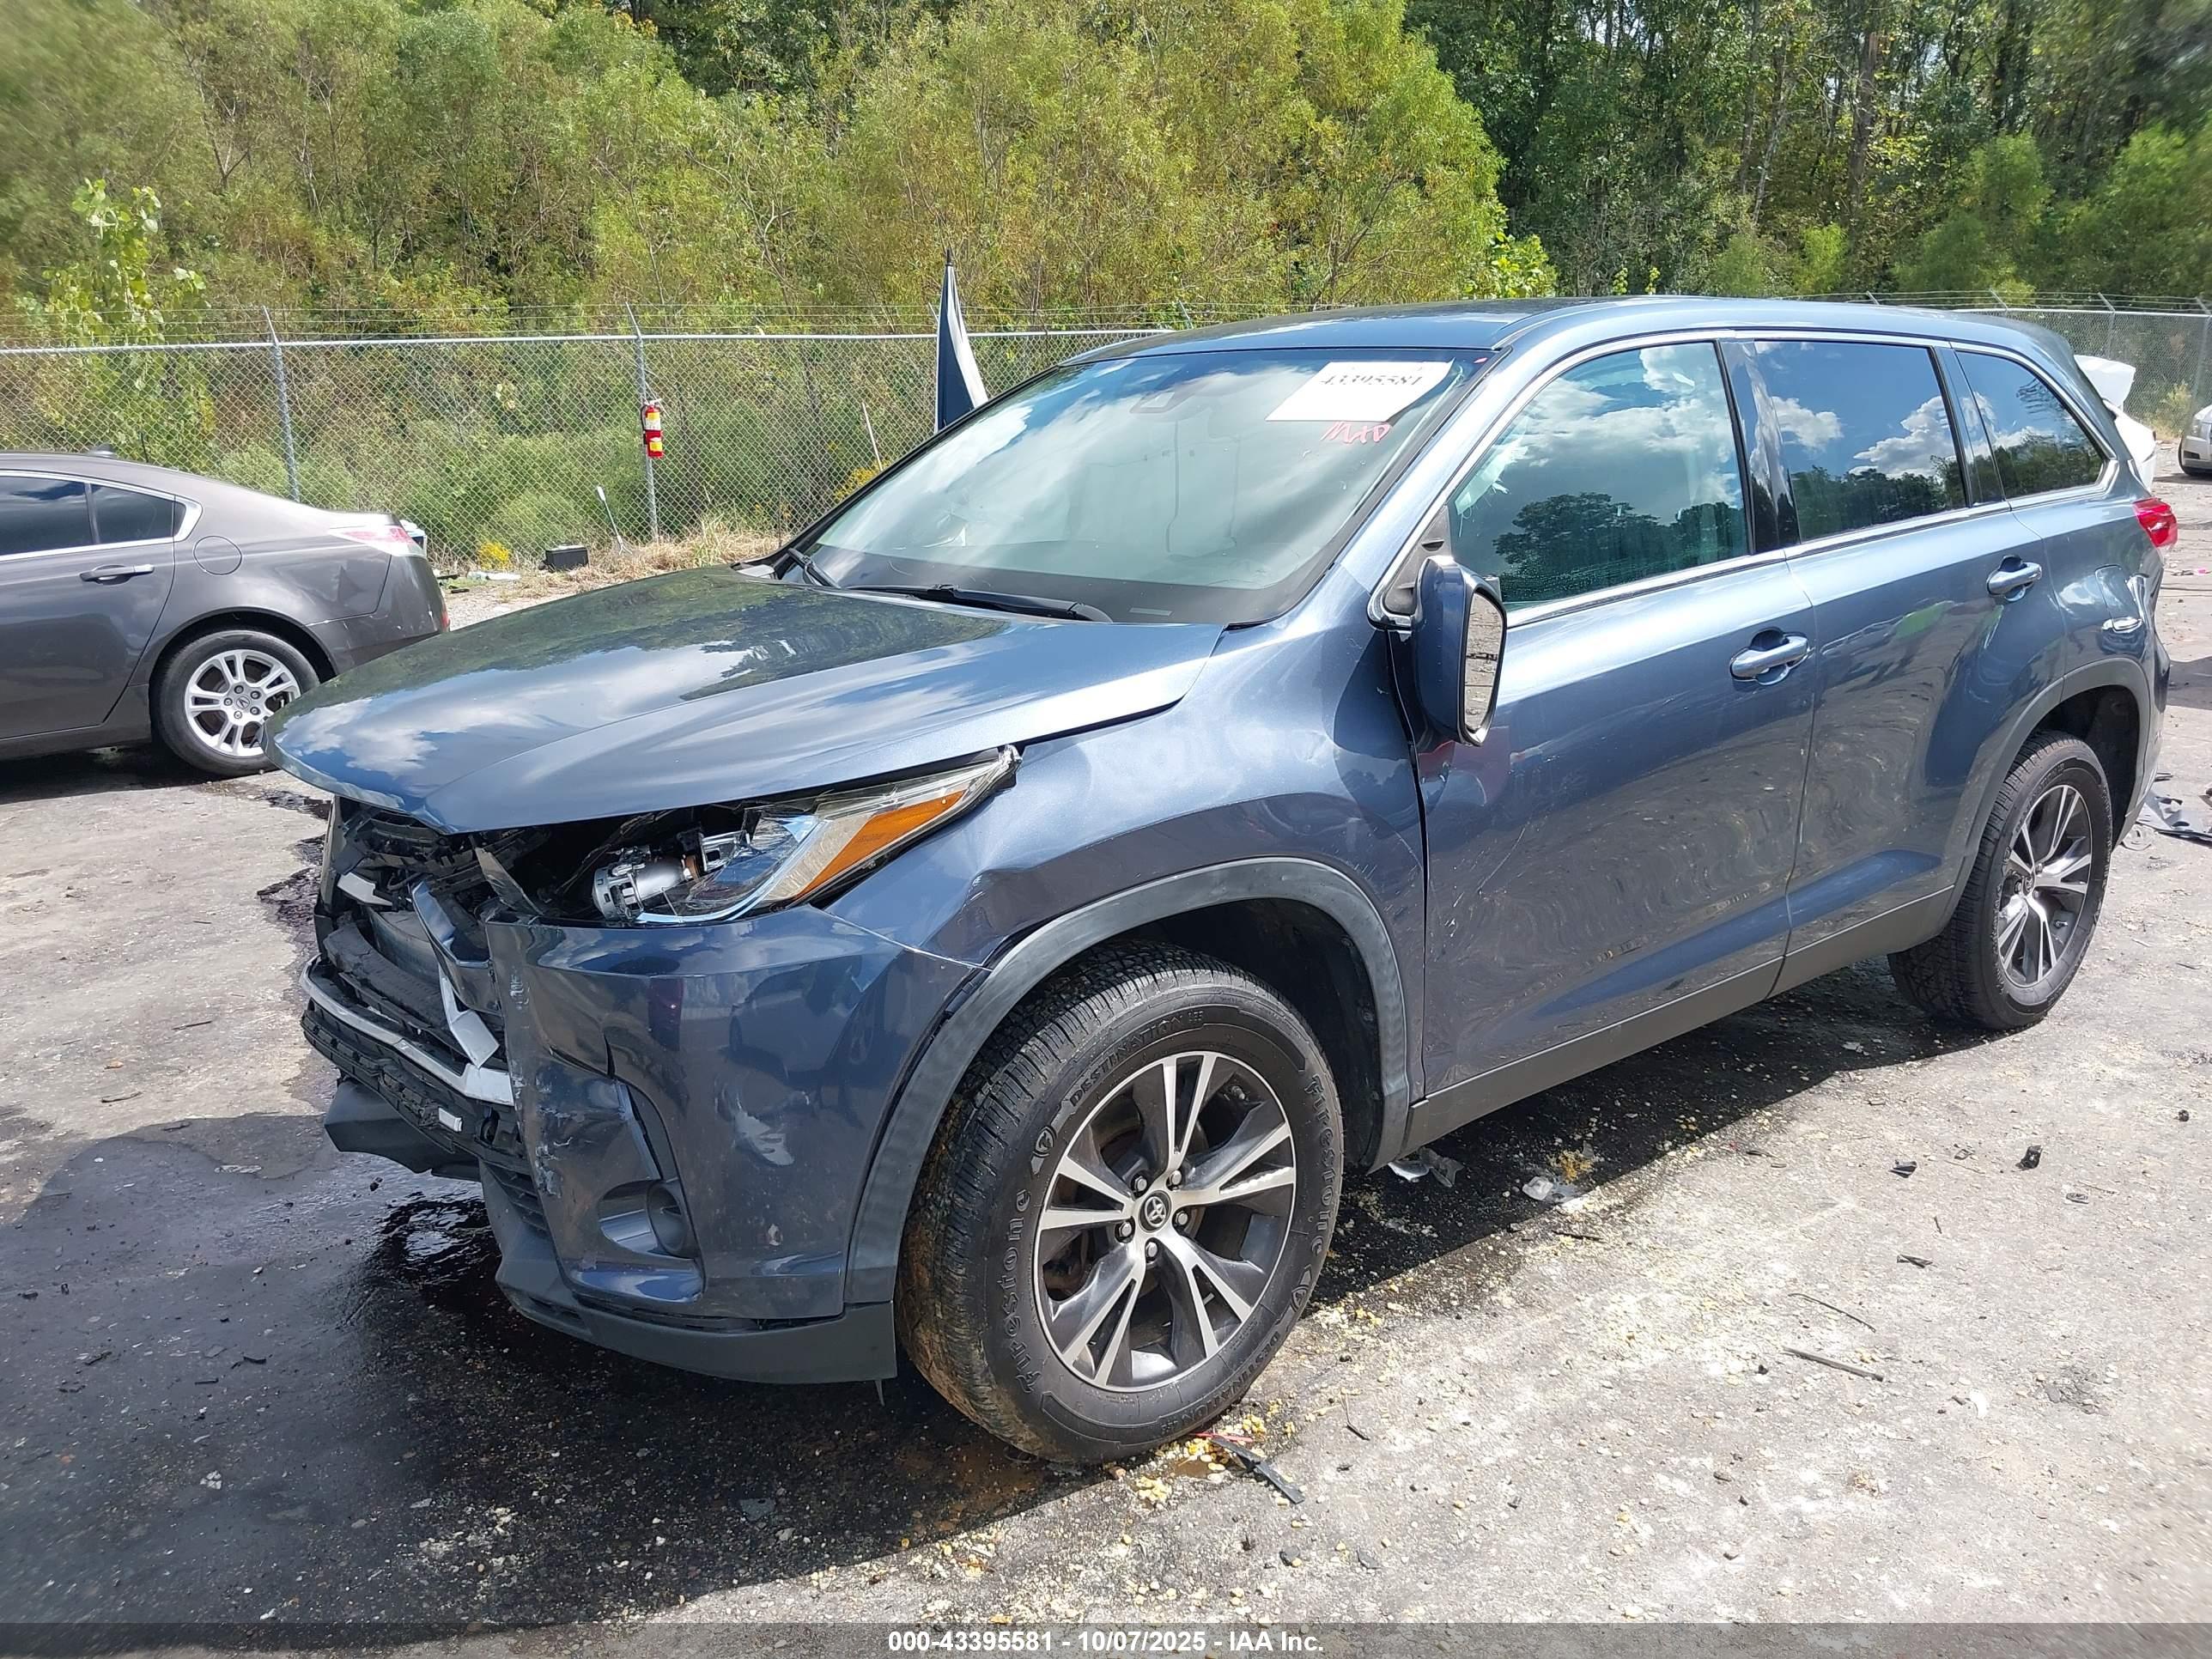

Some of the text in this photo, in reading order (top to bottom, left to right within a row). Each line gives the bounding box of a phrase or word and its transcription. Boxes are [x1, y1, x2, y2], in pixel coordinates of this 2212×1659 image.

[1069, 1014, 1183, 1107] DESTINATION
[1304, 1074, 1335, 1257] Firestone
[997, 1188, 1042, 1394] Firestone
